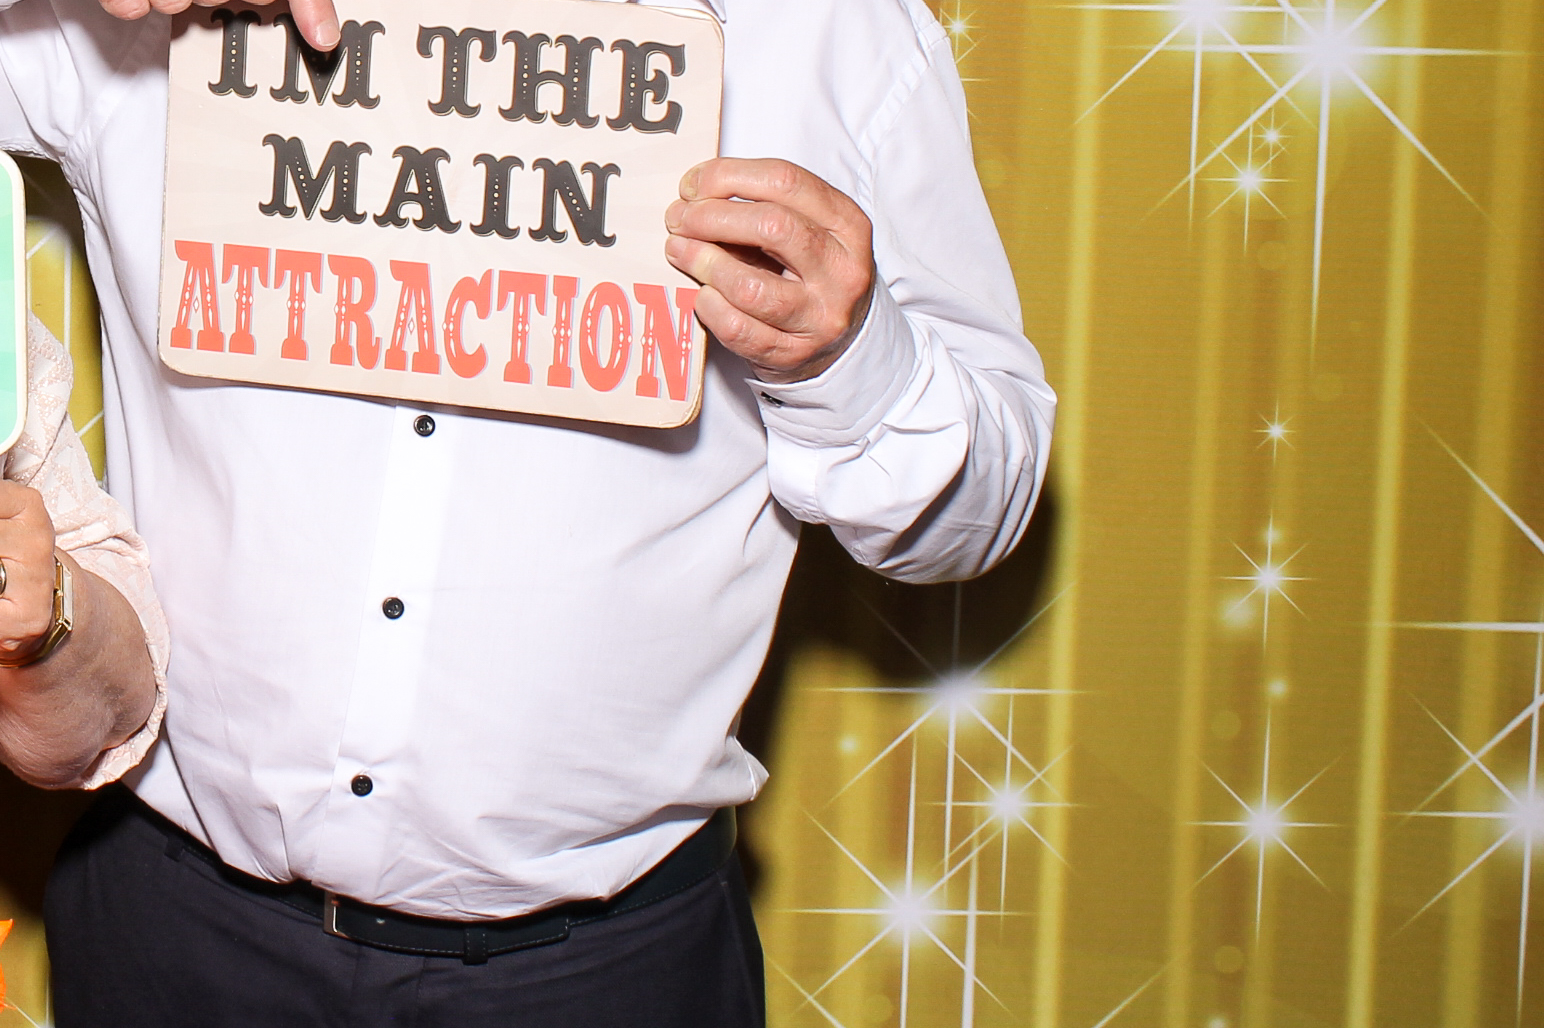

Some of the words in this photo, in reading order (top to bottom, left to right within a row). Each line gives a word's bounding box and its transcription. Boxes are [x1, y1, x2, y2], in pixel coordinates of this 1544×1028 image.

[416, 23, 686, 135] THE
[258, 133, 621, 248] MAIN
[170, 239, 699, 402] ATTRACTION
